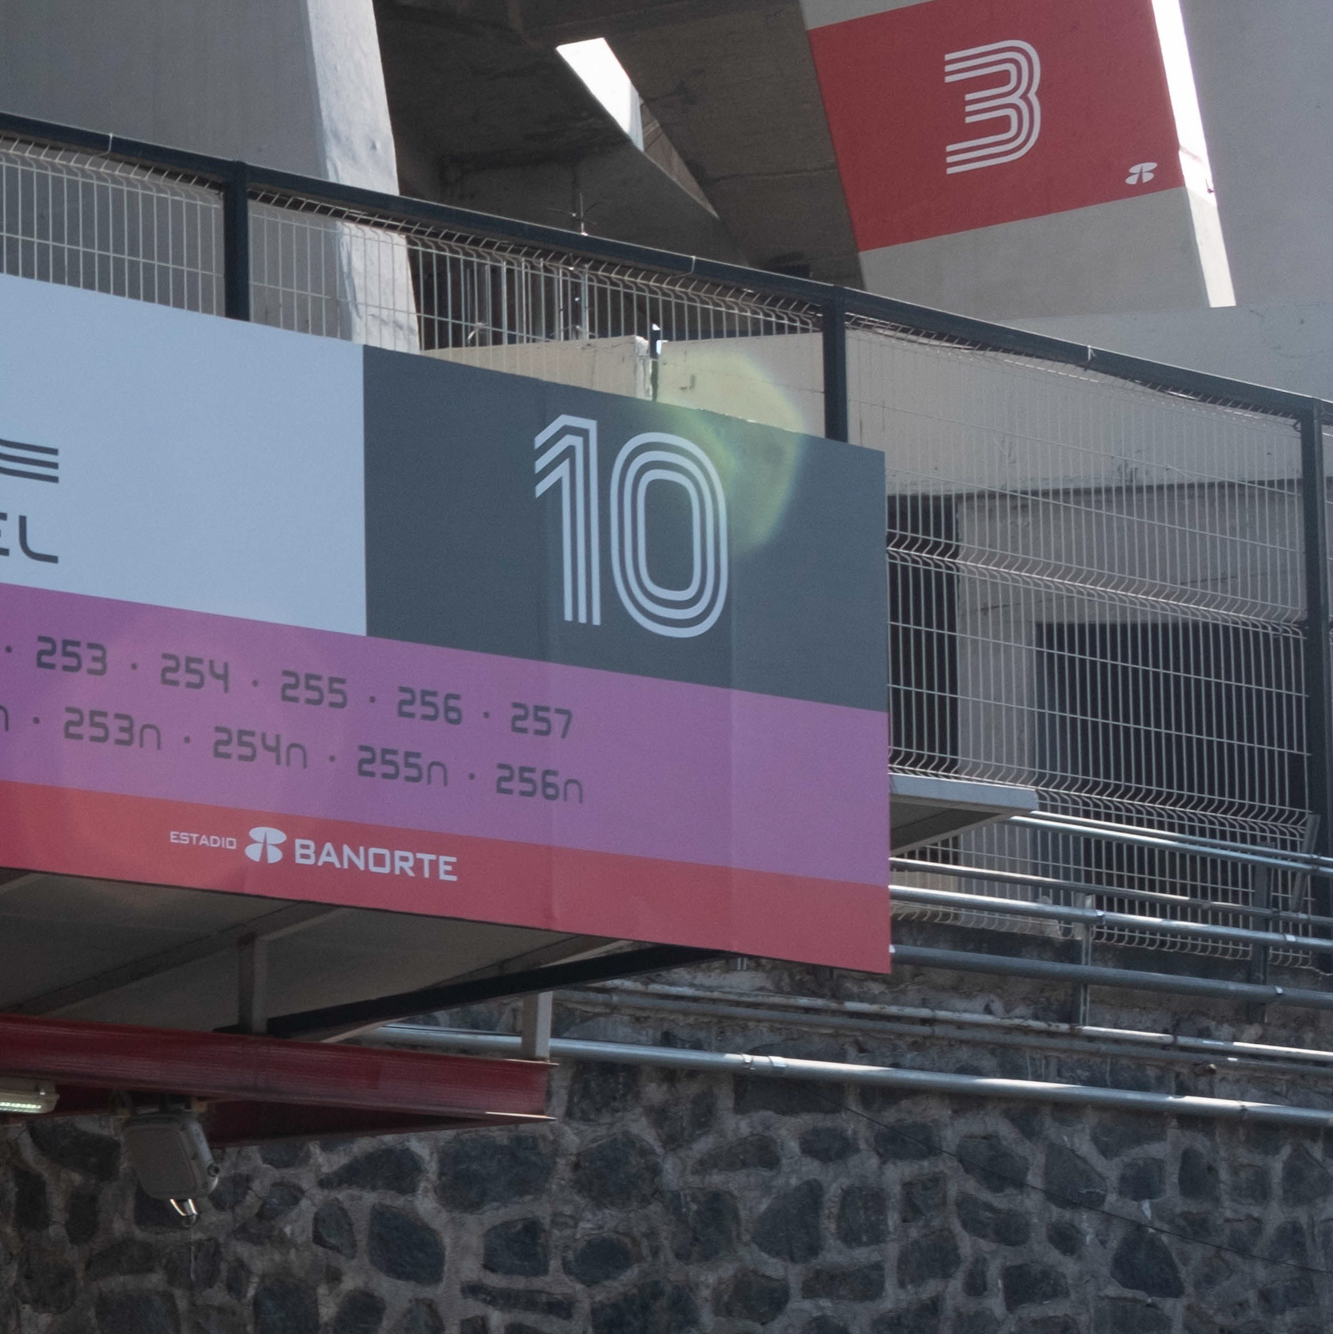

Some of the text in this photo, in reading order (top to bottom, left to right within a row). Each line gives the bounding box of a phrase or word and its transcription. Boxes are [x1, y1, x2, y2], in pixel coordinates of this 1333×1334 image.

[945, 39, 1041, 175] 3
[534, 414, 728, 639] 10
[36, 635, 108, 677] 253
[160, 653, 230, 694] 254
[280, 670, 348, 710] 255
[397, 686, 463, 725] 256
[511, 702, 574, 740] 257
[169, 830, 237, 850] ESTADIO
[294, 838, 458, 882] BANORTE
